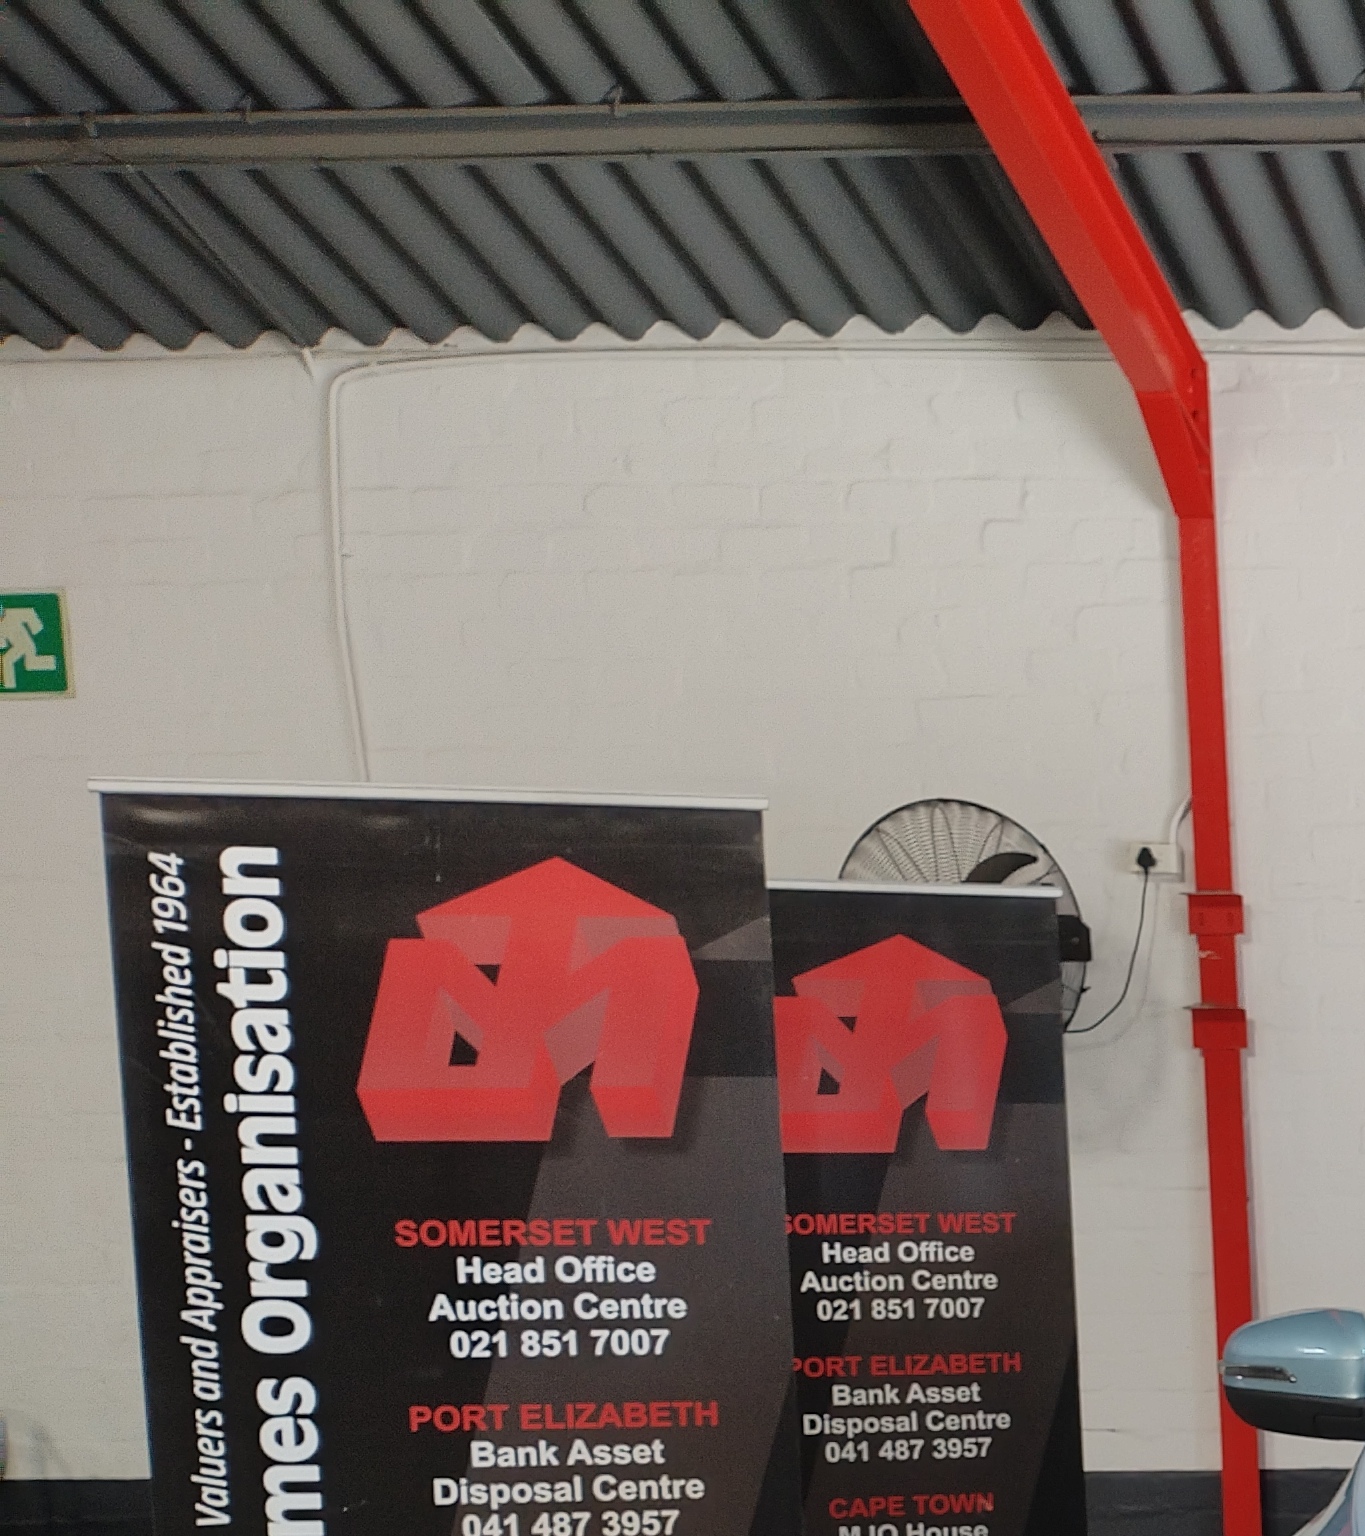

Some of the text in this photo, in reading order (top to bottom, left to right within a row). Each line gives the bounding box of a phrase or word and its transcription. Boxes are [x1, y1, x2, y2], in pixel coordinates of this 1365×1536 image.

[147, 851, 189, 934] 1964
[150, 941, 203, 1131] Established
[213, 845, 318, 1354] Organisation
[394, 1218, 711, 1247] SOMERSET WEST
[937, 1212, 1016, 1234] WEST
[171, 1158, 224, 1332] Appraisers
[821, 1240, 975, 1264] Head Office
[456, 1255, 657, 1284] Head Office
[800, 1269, 999, 1293] Auction Centre
[428, 1291, 688, 1322] Auction Centre
[816, 1296, 985, 1322] 021 851 7007
[449, 1328, 671, 1359] 021 851 7007
[179, 1335, 222, 1402] and
[869, 1352, 1022, 1377] ELIZABETH
[831, 1382, 982, 1406] Bank Asset
[409, 1400, 719, 1432] PORT ELIZABETH
[802, 1409, 1011, 1439] Disposal Centre
[470, 1438, 666, 1468] Bank Asset
[824, 1436, 993, 1463] 041 487 3957
[190, 1408, 232, 1527] Valuers
[433, 1474, 706, 1511] Disposal Centre
[828, 1492, 994, 1519] CAPE TOWN
